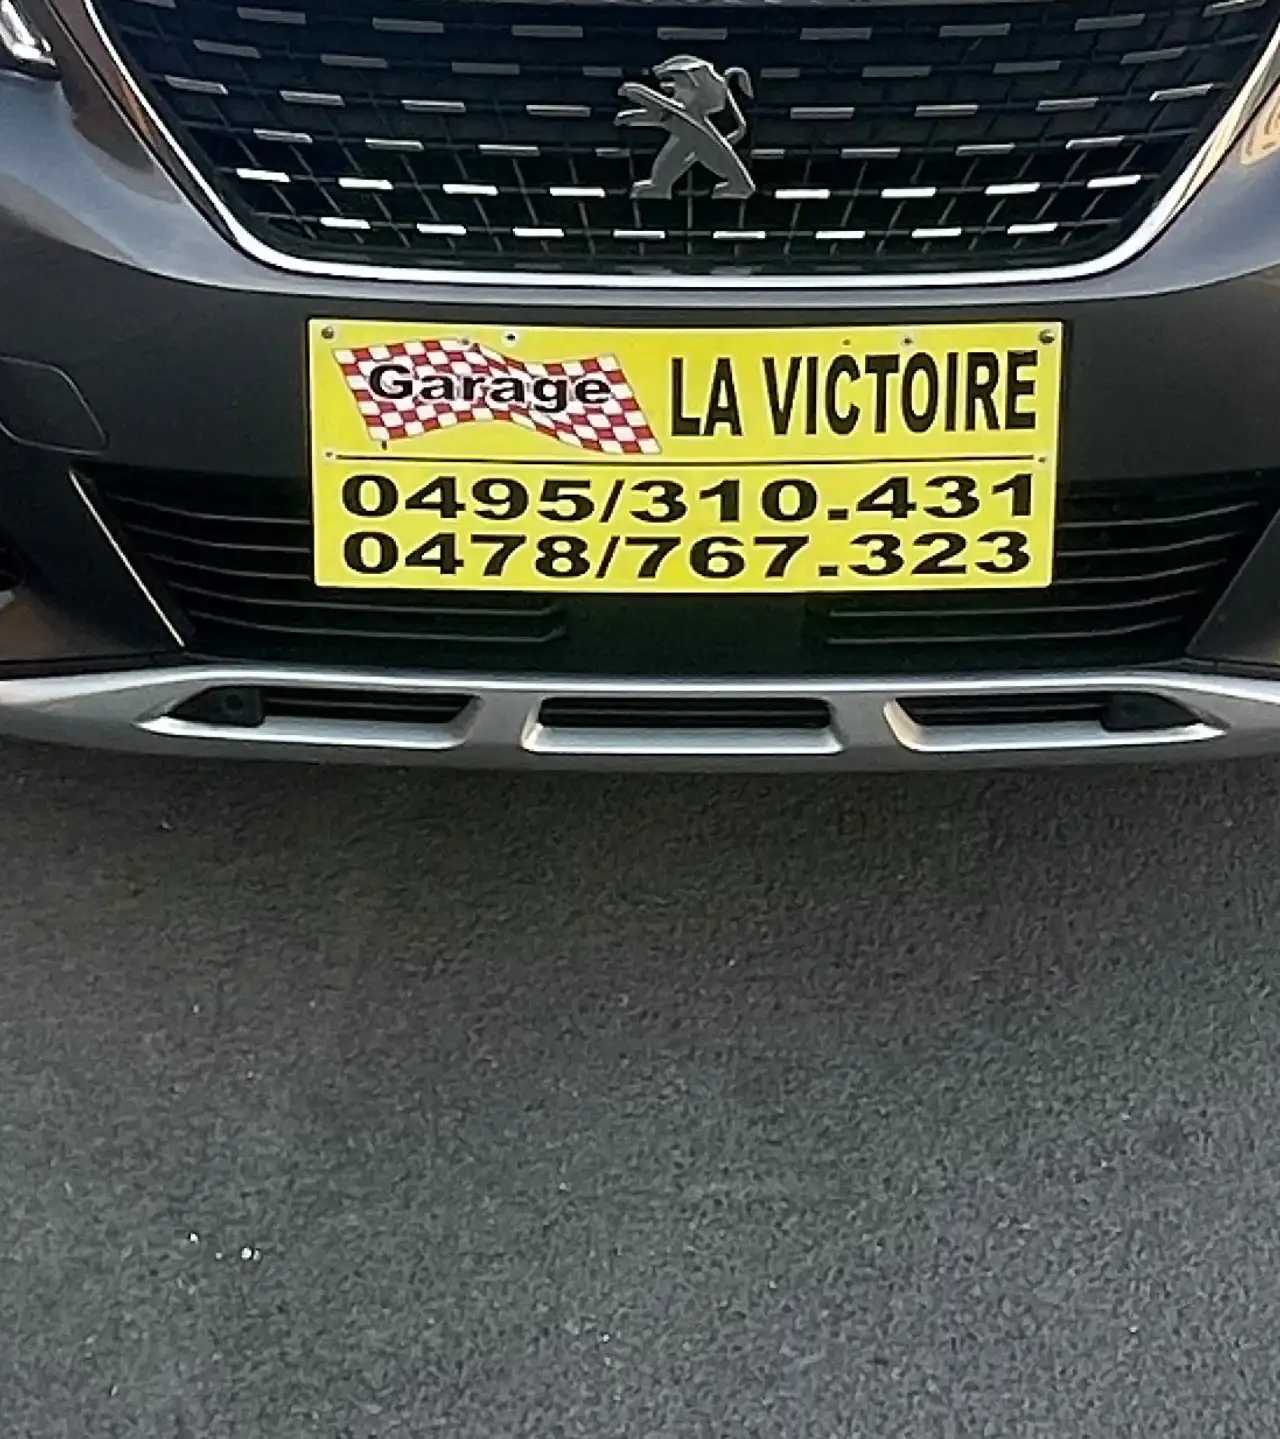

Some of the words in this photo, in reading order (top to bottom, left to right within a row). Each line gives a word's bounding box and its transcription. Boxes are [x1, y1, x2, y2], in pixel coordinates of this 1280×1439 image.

[368, 364, 612, 414] Garage
[671, 357, 742, 437] LA
[762, 349, 1038, 435] VICTOIRE
[342, 474, 1033, 523] 0495/310.431
[344, 531, 1030, 579] 0478/767.323
